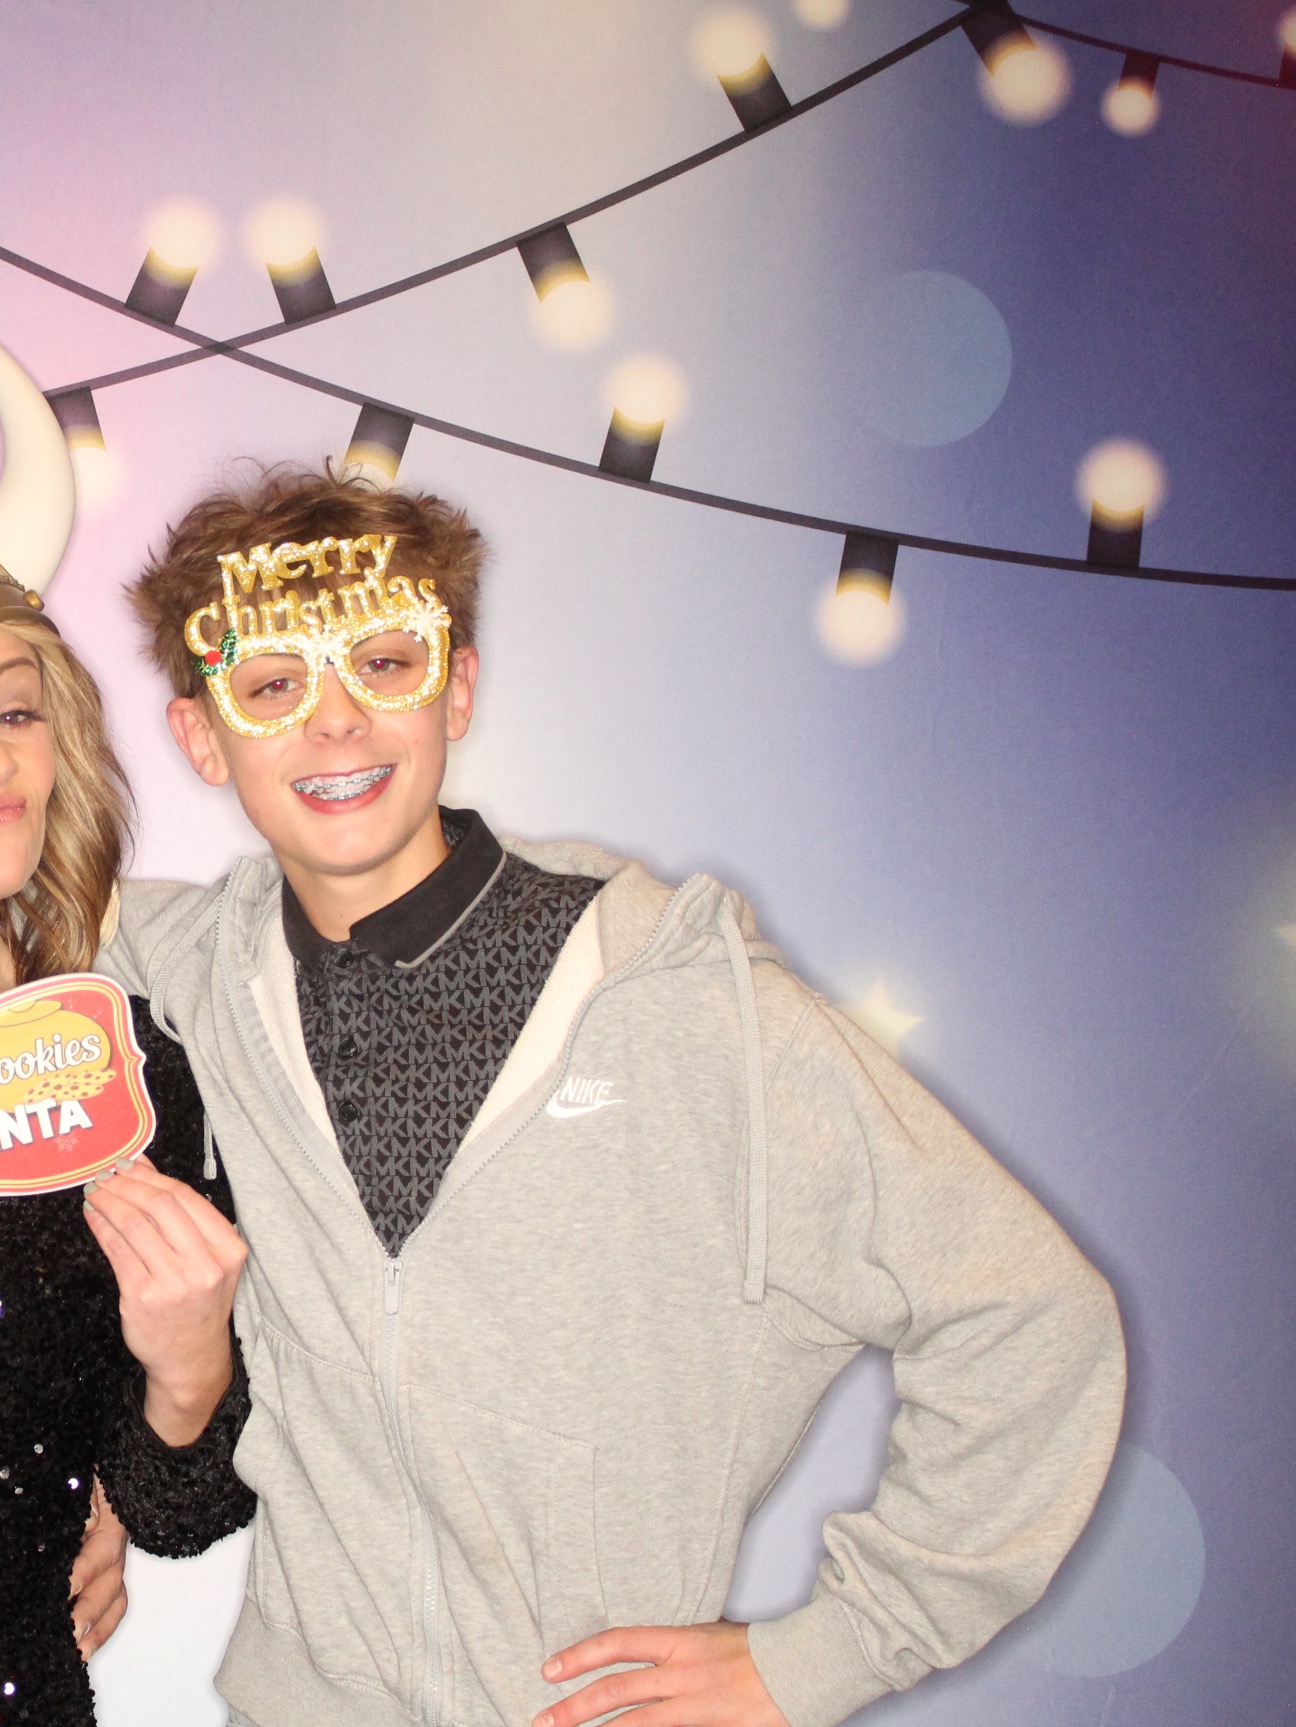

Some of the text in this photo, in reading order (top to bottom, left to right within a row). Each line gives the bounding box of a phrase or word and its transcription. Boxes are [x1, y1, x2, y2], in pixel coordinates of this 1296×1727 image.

[217, 534, 397, 592] Merry
[184, 573, 449, 656] Christmas
[560, 1076, 613, 1105] NIKE
